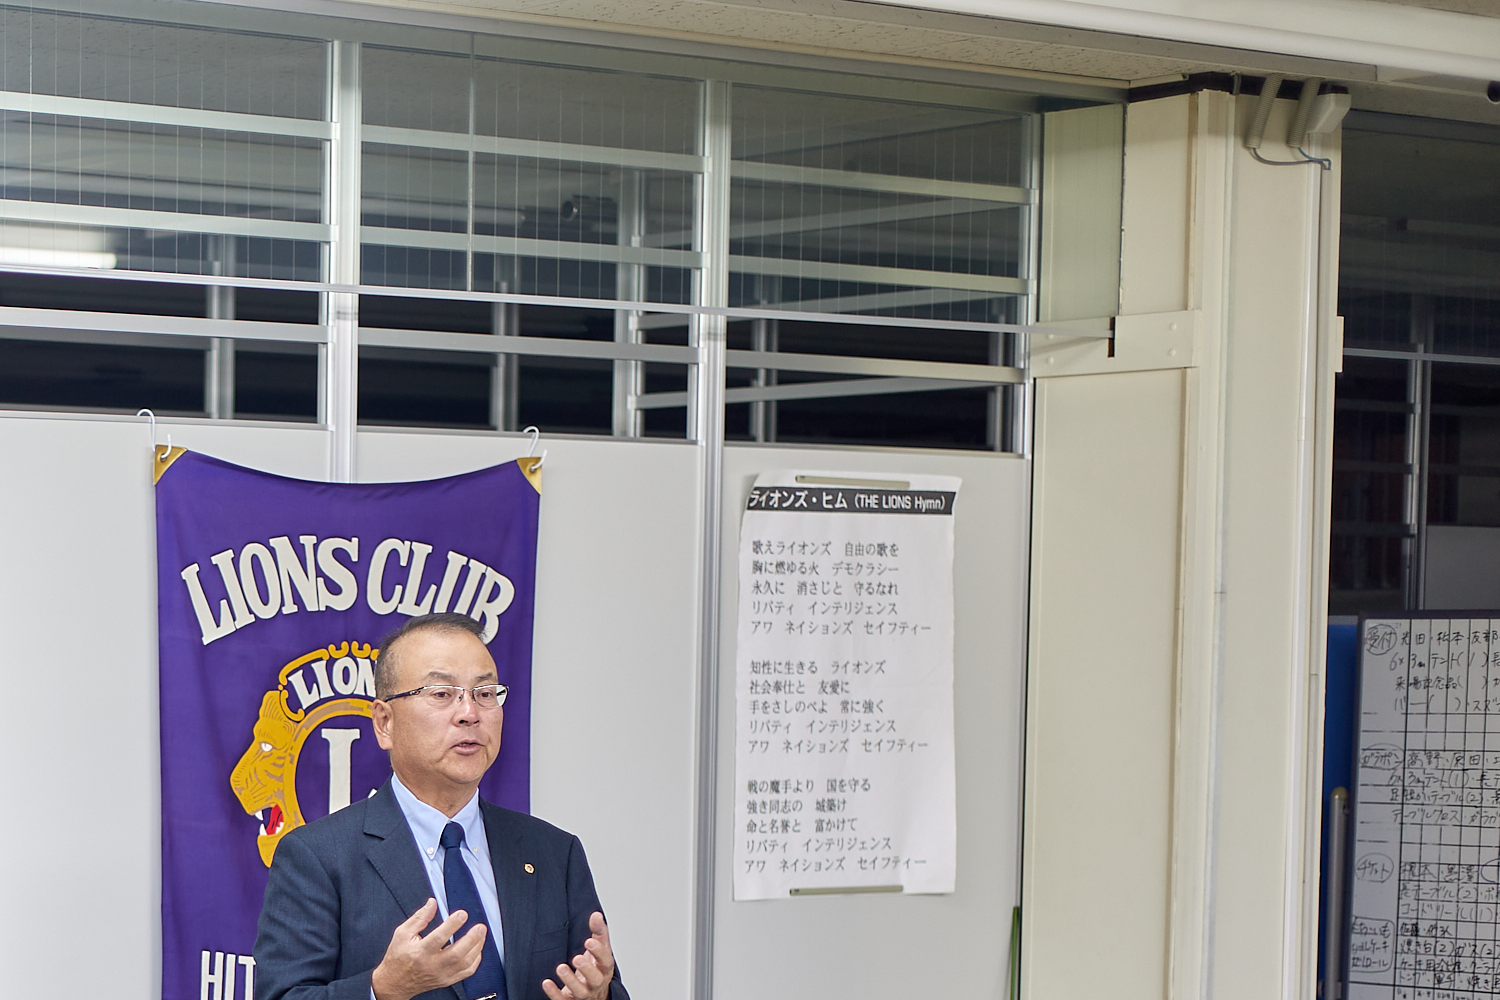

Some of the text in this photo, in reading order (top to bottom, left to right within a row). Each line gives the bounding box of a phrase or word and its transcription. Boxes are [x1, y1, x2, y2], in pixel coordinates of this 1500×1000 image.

[882, 494, 912, 510] LIONS
[752, 539, 900, 558] 歌えライオンズ 自由の歌を
[751, 560, 900, 576] 胸に燃ゆる火 デモクラシー
[181, 534, 516, 646] LIONS CLUB
[750, 580, 900, 597] 永久に 消さじと 守るなれ
[807, 600, 899, 616] インテリジェンス
[750, 619, 932, 636] アワ ネイションズ セイフティー
[749, 659, 887, 675] 知性に生きる ライオンズ
[748, 679, 851, 695] 社会奉仕と 友愛に
[749, 699, 885, 715] 手をさしのべよ 常に強く
[805, 718, 897, 734] インテリジェンス
[747, 738, 929, 754] アワ ネイションズ セイフティー
[746, 777, 872, 795] 戦の魔手より 国を守る
[746, 798, 848, 815] 強き同志の 城築け
[746, 817, 859, 835] 命と名誉と 富かけて
[801, 836, 893, 853] インテリジェンス
[744, 855, 927, 874] アワ ネイションズ セイフティー
